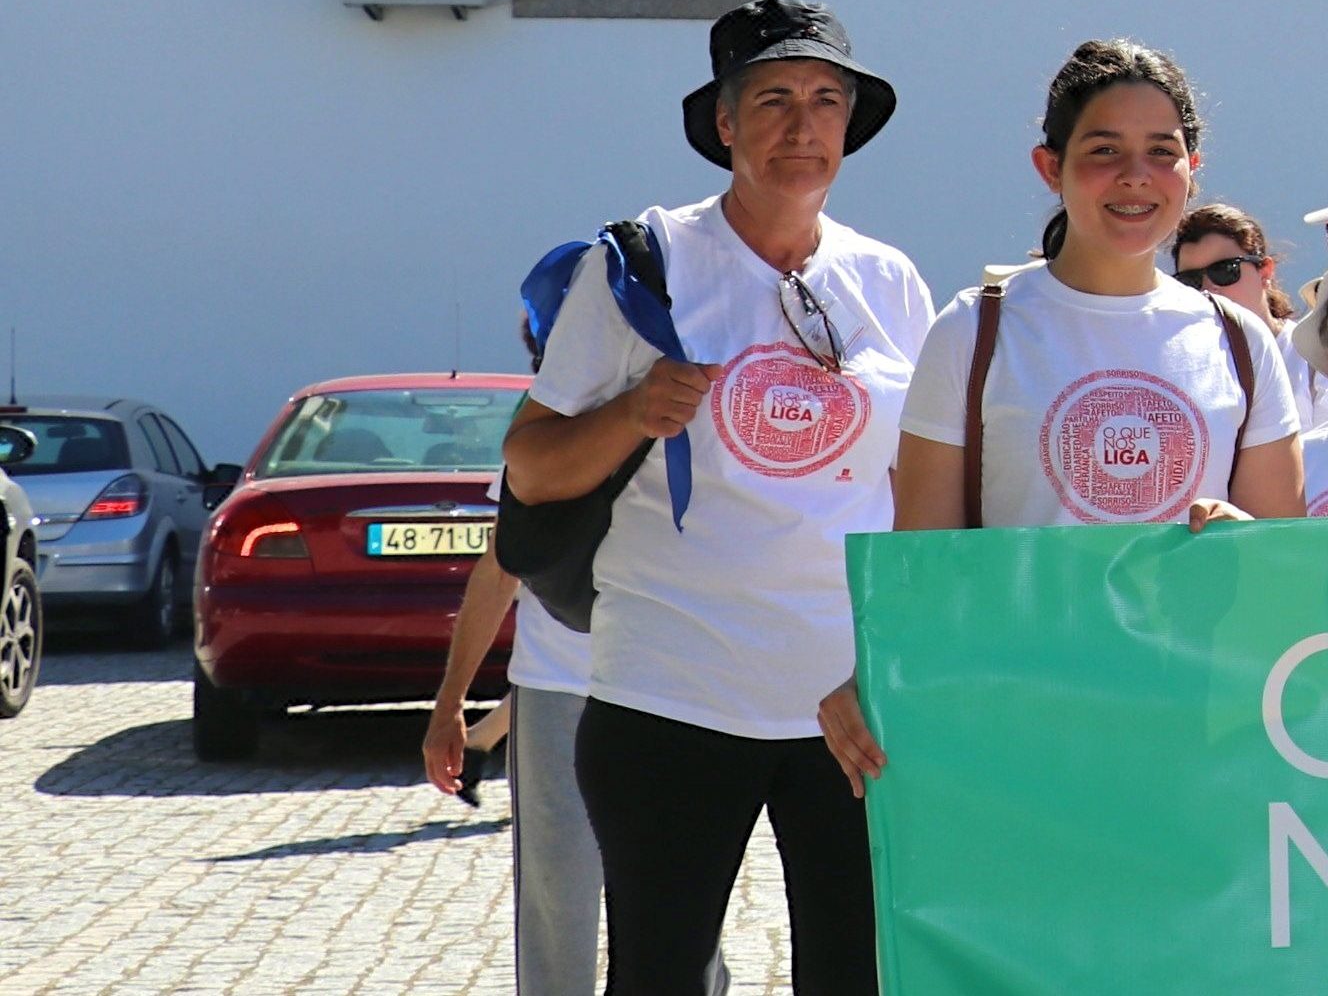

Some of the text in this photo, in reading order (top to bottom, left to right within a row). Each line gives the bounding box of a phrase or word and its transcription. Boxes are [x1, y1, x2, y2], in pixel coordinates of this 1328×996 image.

[770, 406, 813, 422] LIGA
[1147, 412, 1182, 423] AFETO
[1103, 426, 1151, 440] O QUE
[1061, 424, 1072, 471] DEDICAÇÃO
[1103, 437, 1136, 450] NOS
[1104, 449, 1149, 465] LIGA
[1171, 459, 1184, 485] VIDA
